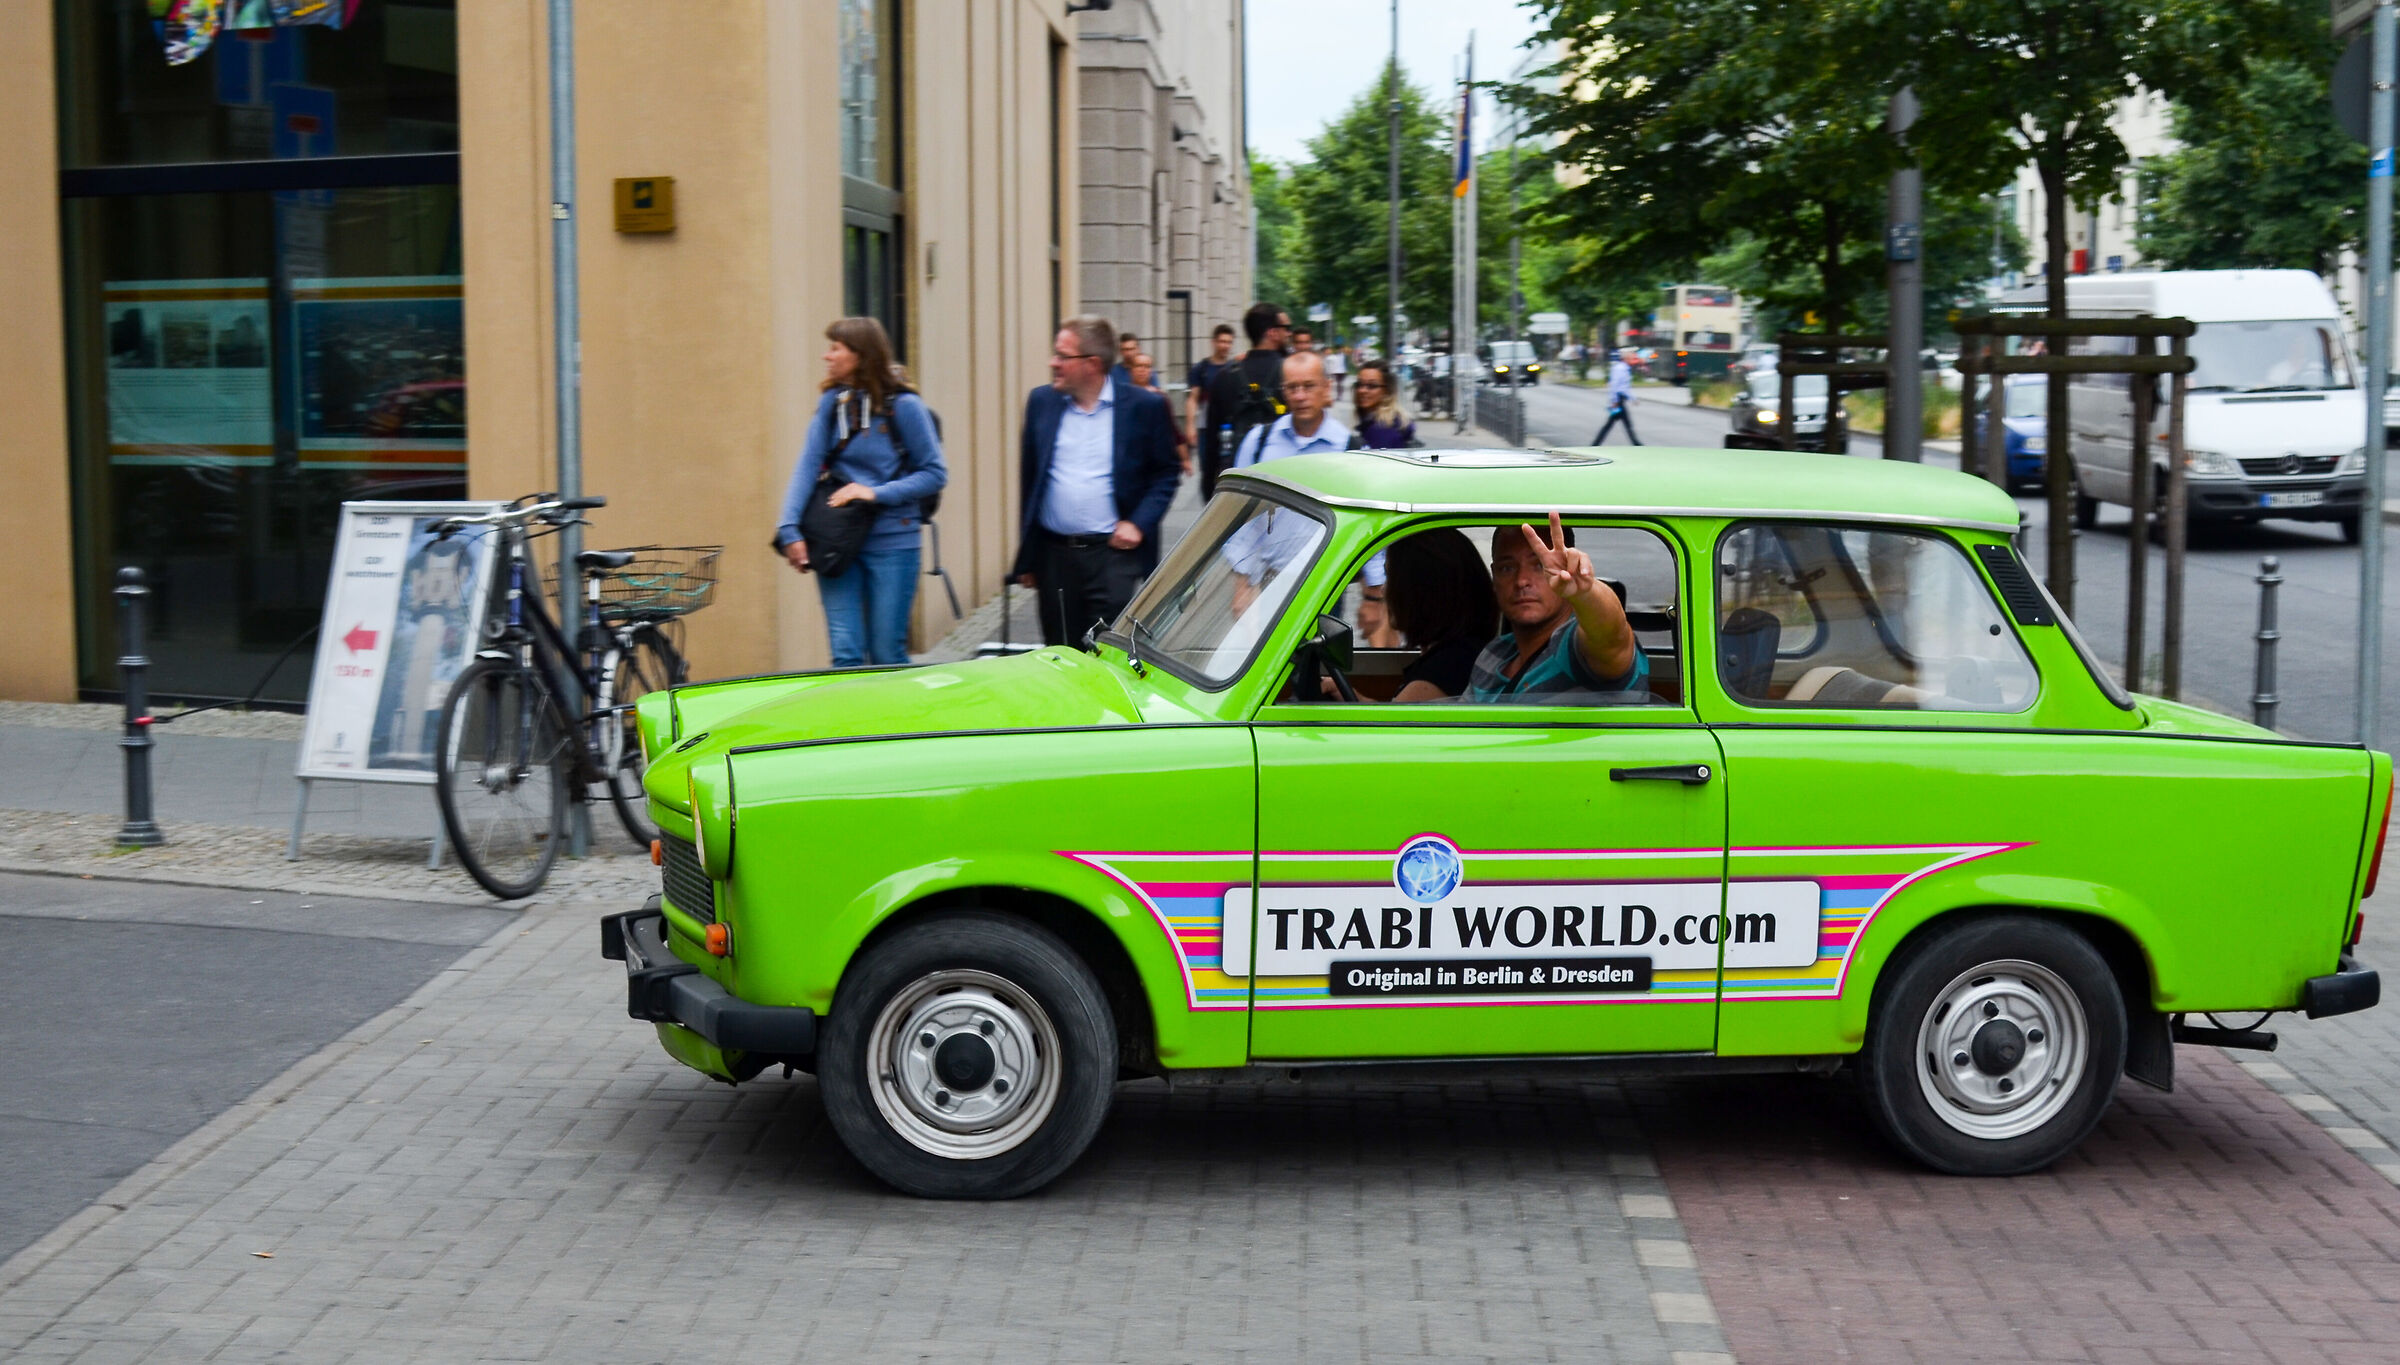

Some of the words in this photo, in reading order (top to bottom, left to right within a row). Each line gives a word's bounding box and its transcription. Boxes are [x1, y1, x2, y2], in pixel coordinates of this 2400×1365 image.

[1266, 906, 1433, 951] TRABI
[1451, 903, 1777, 949] WORLD.com
[1347, 967, 1432, 992] Original
[1437, 967, 1457, 986] in
[1463, 966, 1524, 986] Berlin
[1529, 966, 1546, 985] &
[1552, 965, 1634, 984] Dresden
